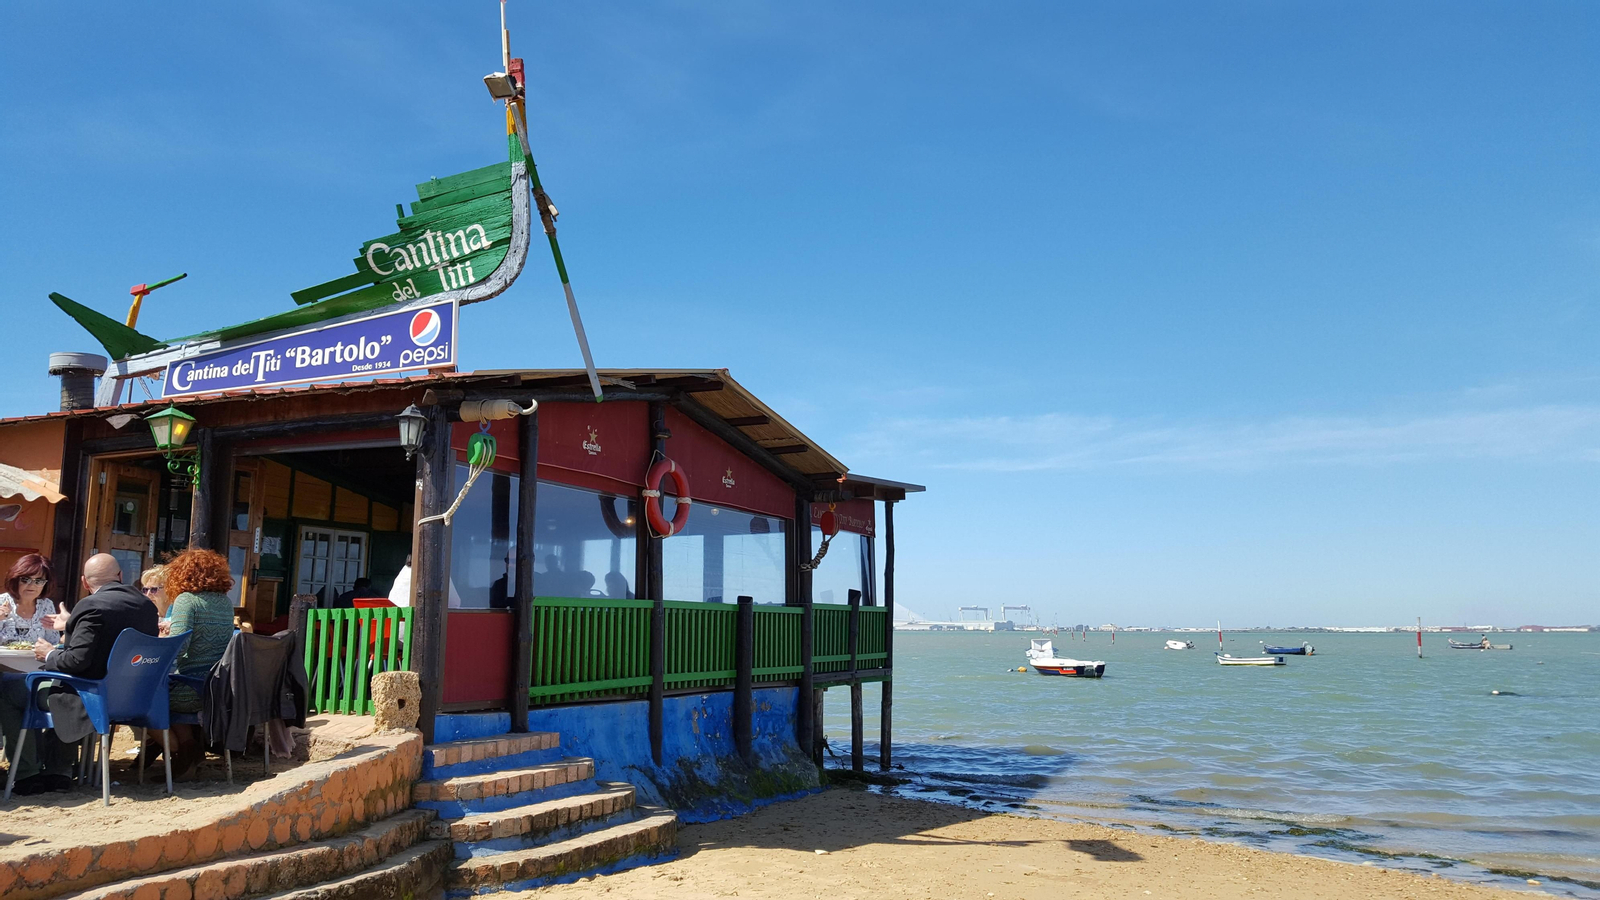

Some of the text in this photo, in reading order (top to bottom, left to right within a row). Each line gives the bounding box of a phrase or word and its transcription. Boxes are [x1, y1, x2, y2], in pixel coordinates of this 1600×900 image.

[366, 223, 493, 276] Cantina
[392, 260, 476, 302] del Titi
[172, 360, 229, 391] Cantina
[232, 359, 254, 376] del
[251, 349, 281, 382] Titi
[352, 361, 391, 372] Desde 1934
[399, 341, 449, 368] pepsi
[141, 655, 161, 665] pepsi
